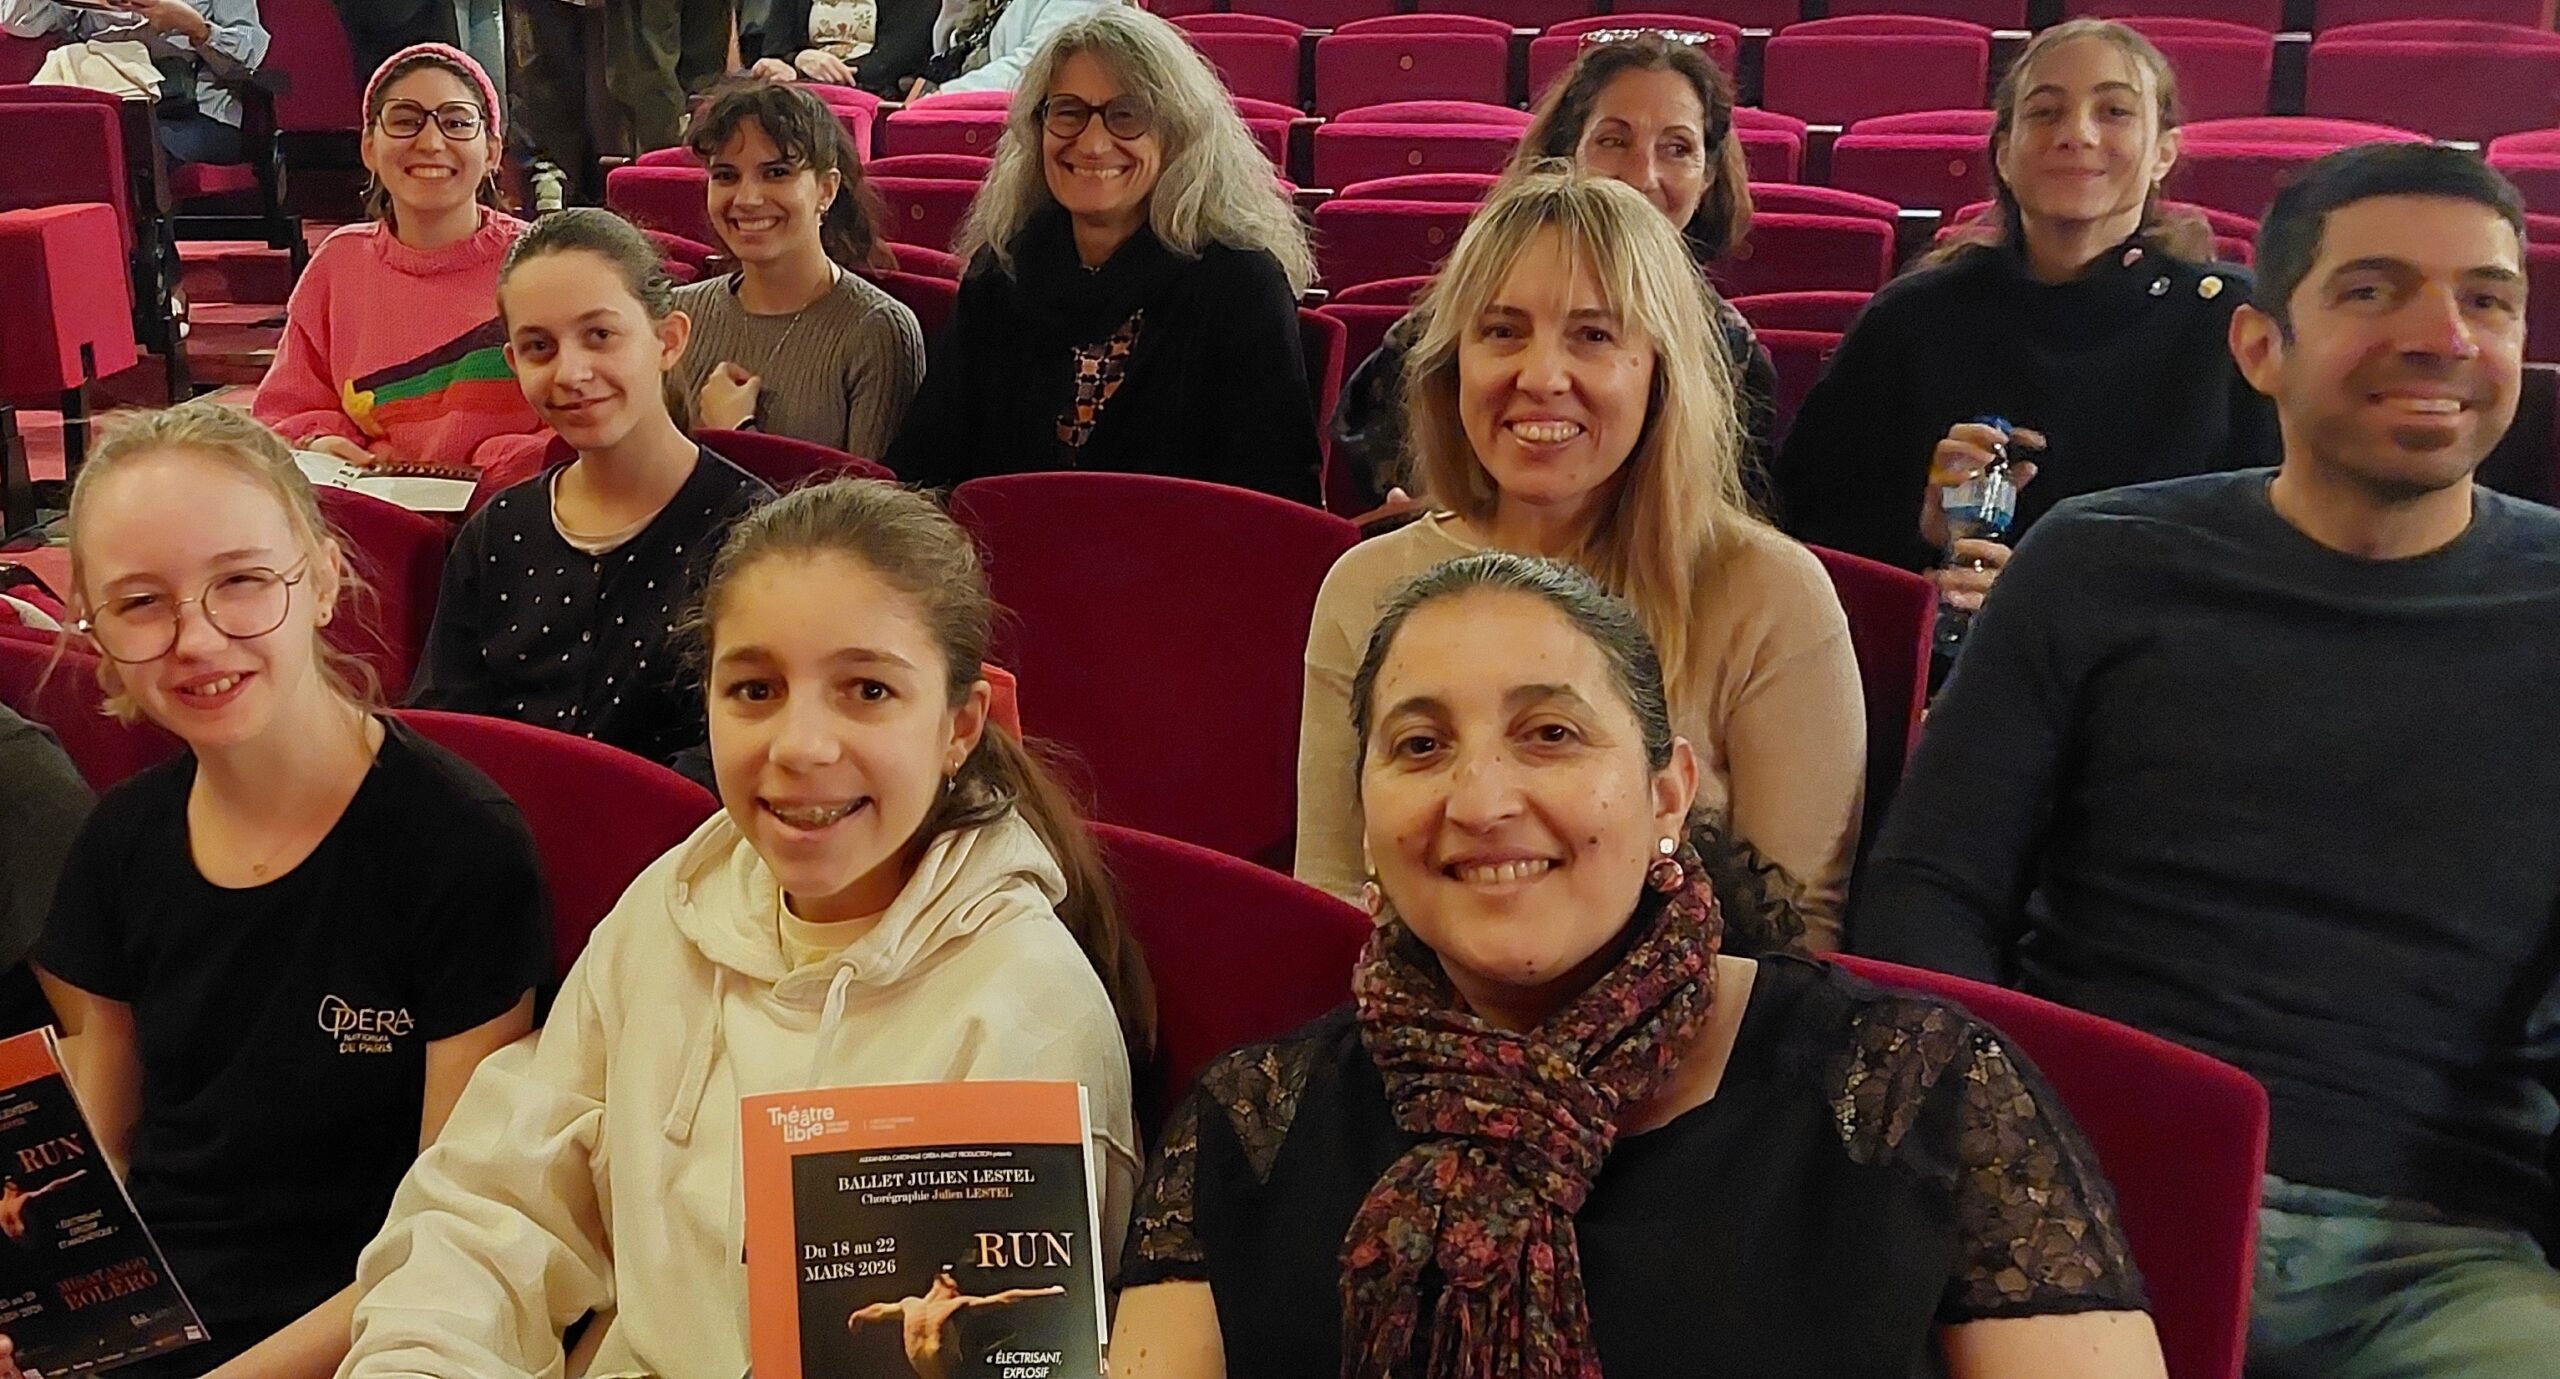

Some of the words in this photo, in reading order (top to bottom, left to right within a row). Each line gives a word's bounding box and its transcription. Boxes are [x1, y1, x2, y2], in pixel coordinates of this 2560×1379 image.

[339, 1043, 357, 1054] DE
[359, 1042, 393, 1054] PARIS
[783, 1122, 824, 1143] Libre
[16, 1132, 86, 1174] RUN
[838, 1172, 904, 1191] BALLET
[907, 1169, 970, 1187] JULIEN
[973, 1168, 1036, 1184] LESTEL
[860, 1189, 930, 1206] Chorégraphie
[931, 1188, 964, 1201] Julien
[966, 1186, 1014, 1200] LESTEL
[804, 1243, 827, 1260] Du
[831, 1240, 850, 1257] 18
[853, 1241, 872, 1255] au
[876, 1237, 896, 1253] 22
[973, 1231, 1075, 1268] RUN
[804, 1263, 855, 1282] MARS
[858, 1259, 897, 1277] 2026
[995, 1349, 1063, 1366] ÉLECTRISANT,
[1003, 1366, 1050, 1379] EXPLOSIF
